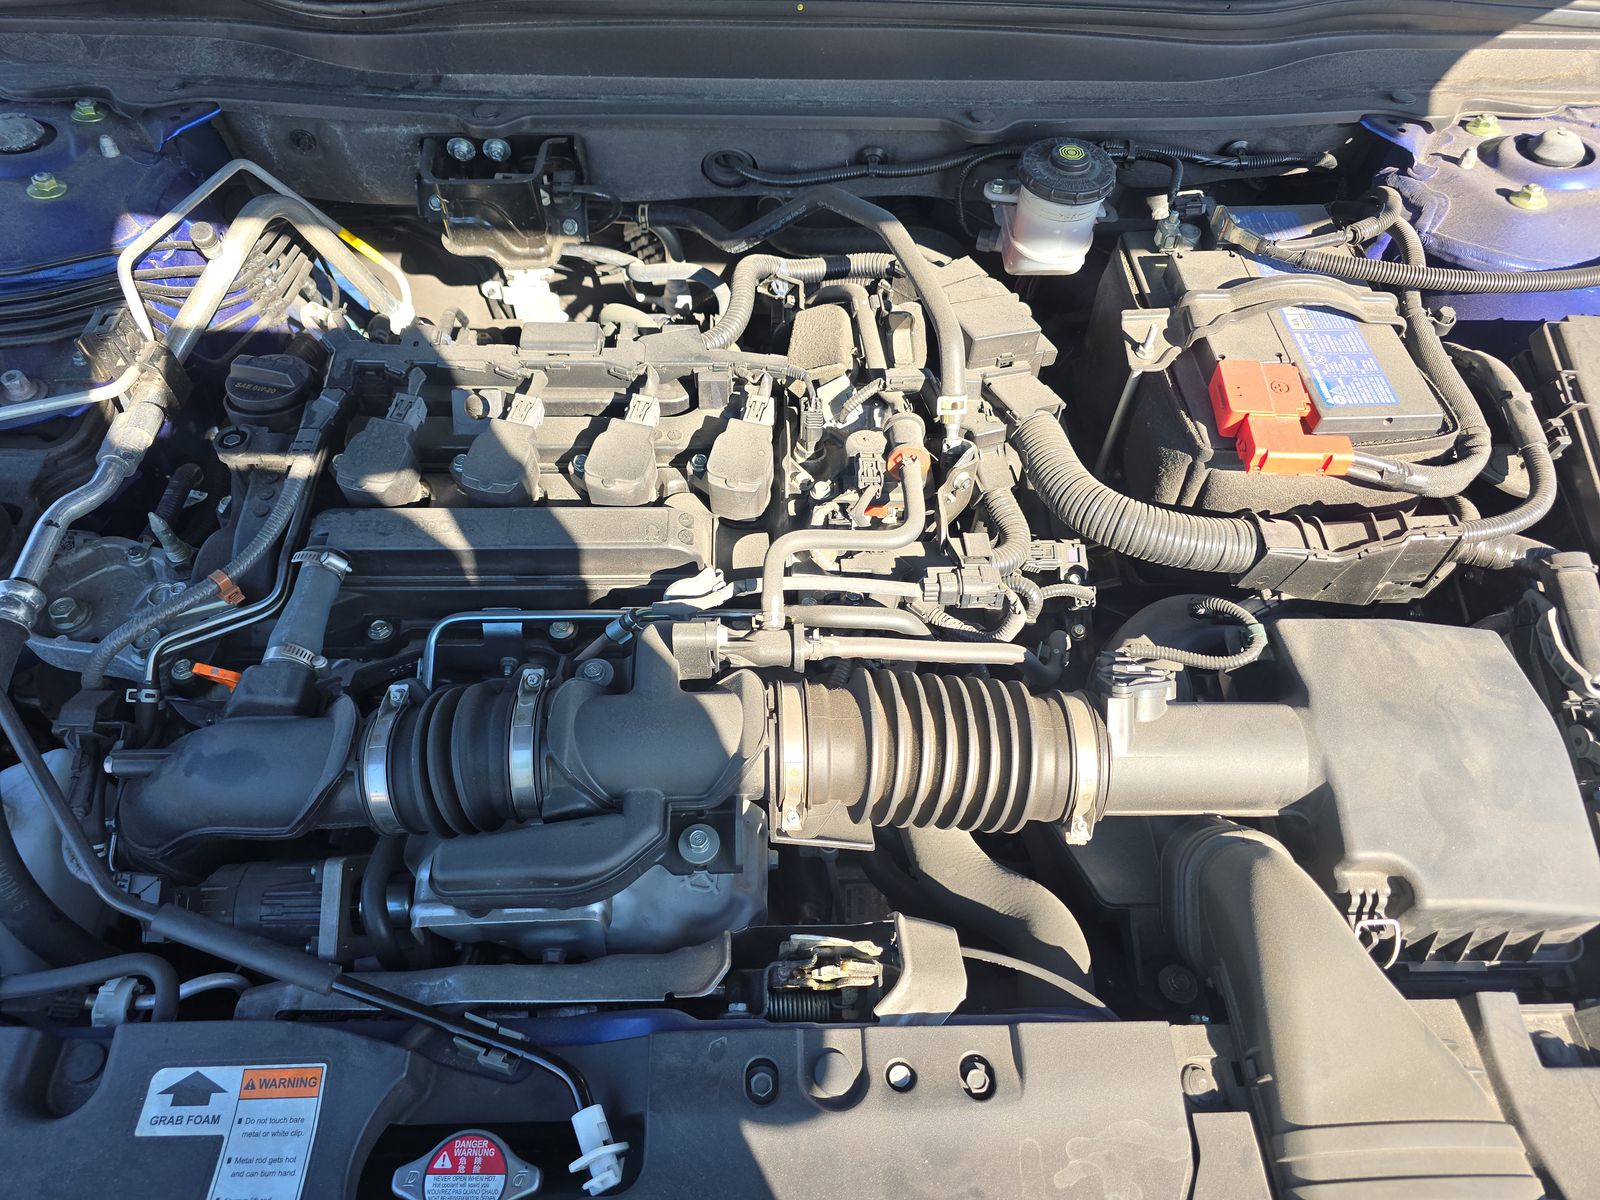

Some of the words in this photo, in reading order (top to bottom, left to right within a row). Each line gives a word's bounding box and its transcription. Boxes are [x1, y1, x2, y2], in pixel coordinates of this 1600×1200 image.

[258, 1077, 318, 1090] WARNING
[150, 1115, 184, 1126] GRAB
[186, 1114, 221, 1125] FOAM
[245, 1117, 255, 1125] Do
[289, 1116, 305, 1124] bare
[241, 1130, 261, 1138] metal
[271, 1129, 289, 1137] white
[290, 1129, 304, 1138] clip.
[454, 1140, 489, 1148] DANGER
[454, 1148, 495, 1157] WARNUNG
[267, 1157, 284, 1165] gets
[230, 1170, 245, 1178] and
[277, 1169, 297, 1177] hand.
